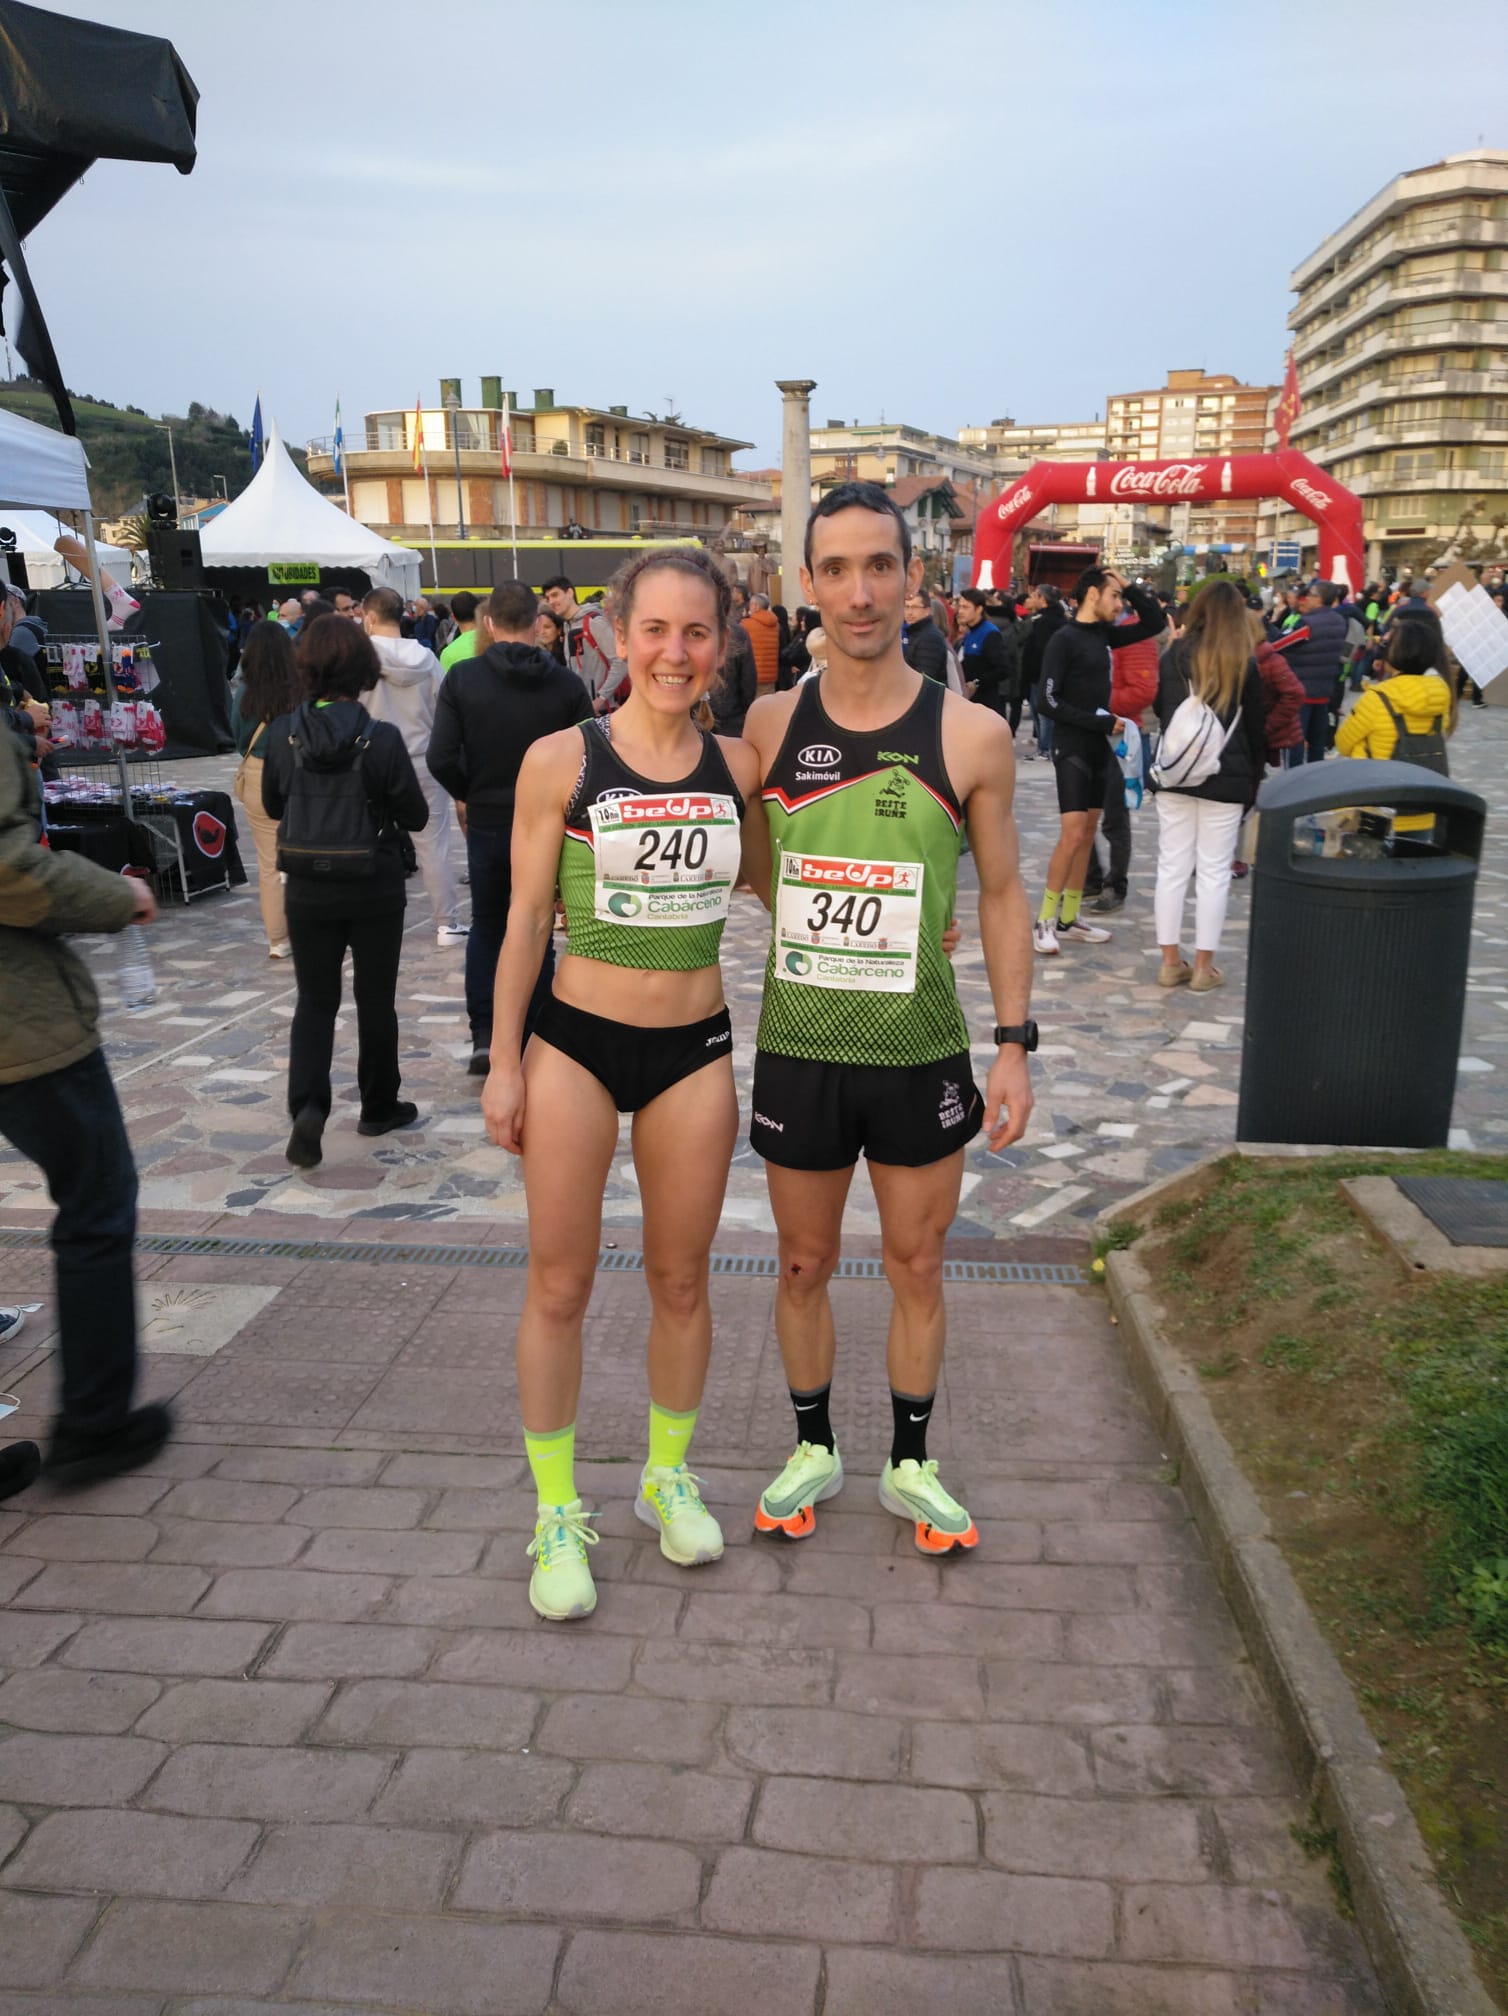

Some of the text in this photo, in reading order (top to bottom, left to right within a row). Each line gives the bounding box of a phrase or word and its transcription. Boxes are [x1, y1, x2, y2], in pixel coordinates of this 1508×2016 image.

[1110, 464, 1208, 496] Coca-Cola
[805, 750, 834, 762] KIA
[795, 771, 841, 781] Sakimóvil
[634, 827, 708, 870] 240
[648, 893, 676, 901] Parque
[688, 891, 696, 899] la
[647, 896, 722, 913] Cabárceno
[807, 892, 882, 936] 340
[818, 955, 844, 963] Parque
[817, 962, 905, 977] Cabárceno
